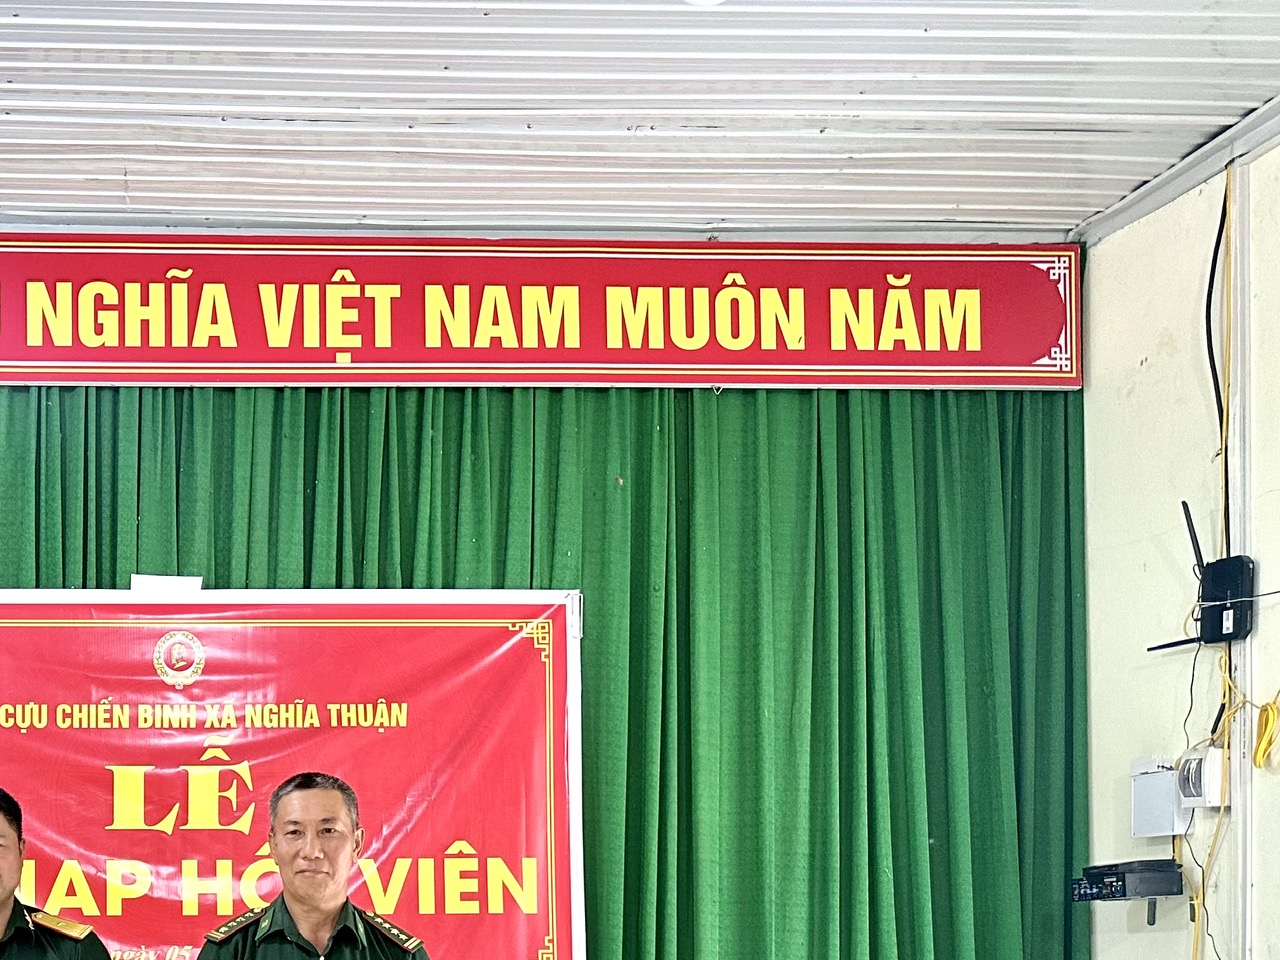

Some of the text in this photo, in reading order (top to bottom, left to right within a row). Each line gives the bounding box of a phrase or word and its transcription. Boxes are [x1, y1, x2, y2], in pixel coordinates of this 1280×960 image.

[27, 268, 237, 349] NGHĨA
[259, 269, 401, 364] VIỆT
[425, 283, 581, 350] NAM
[606, 273, 807, 352] MUÔN
[830, 273, 981, 352] NĂM
[0, 702, 48, 733] CỰU
[56, 697, 130, 729] CHIẾN
[137, 703, 197, 729] BINH
[204, 700, 238, 729] XÃ
[244, 699, 321, 729] NGHĨA
[326, 698, 408, 733] THUẬN
[104, 734, 256, 835] LỄ
[358, 840, 538, 915] VIÊN
